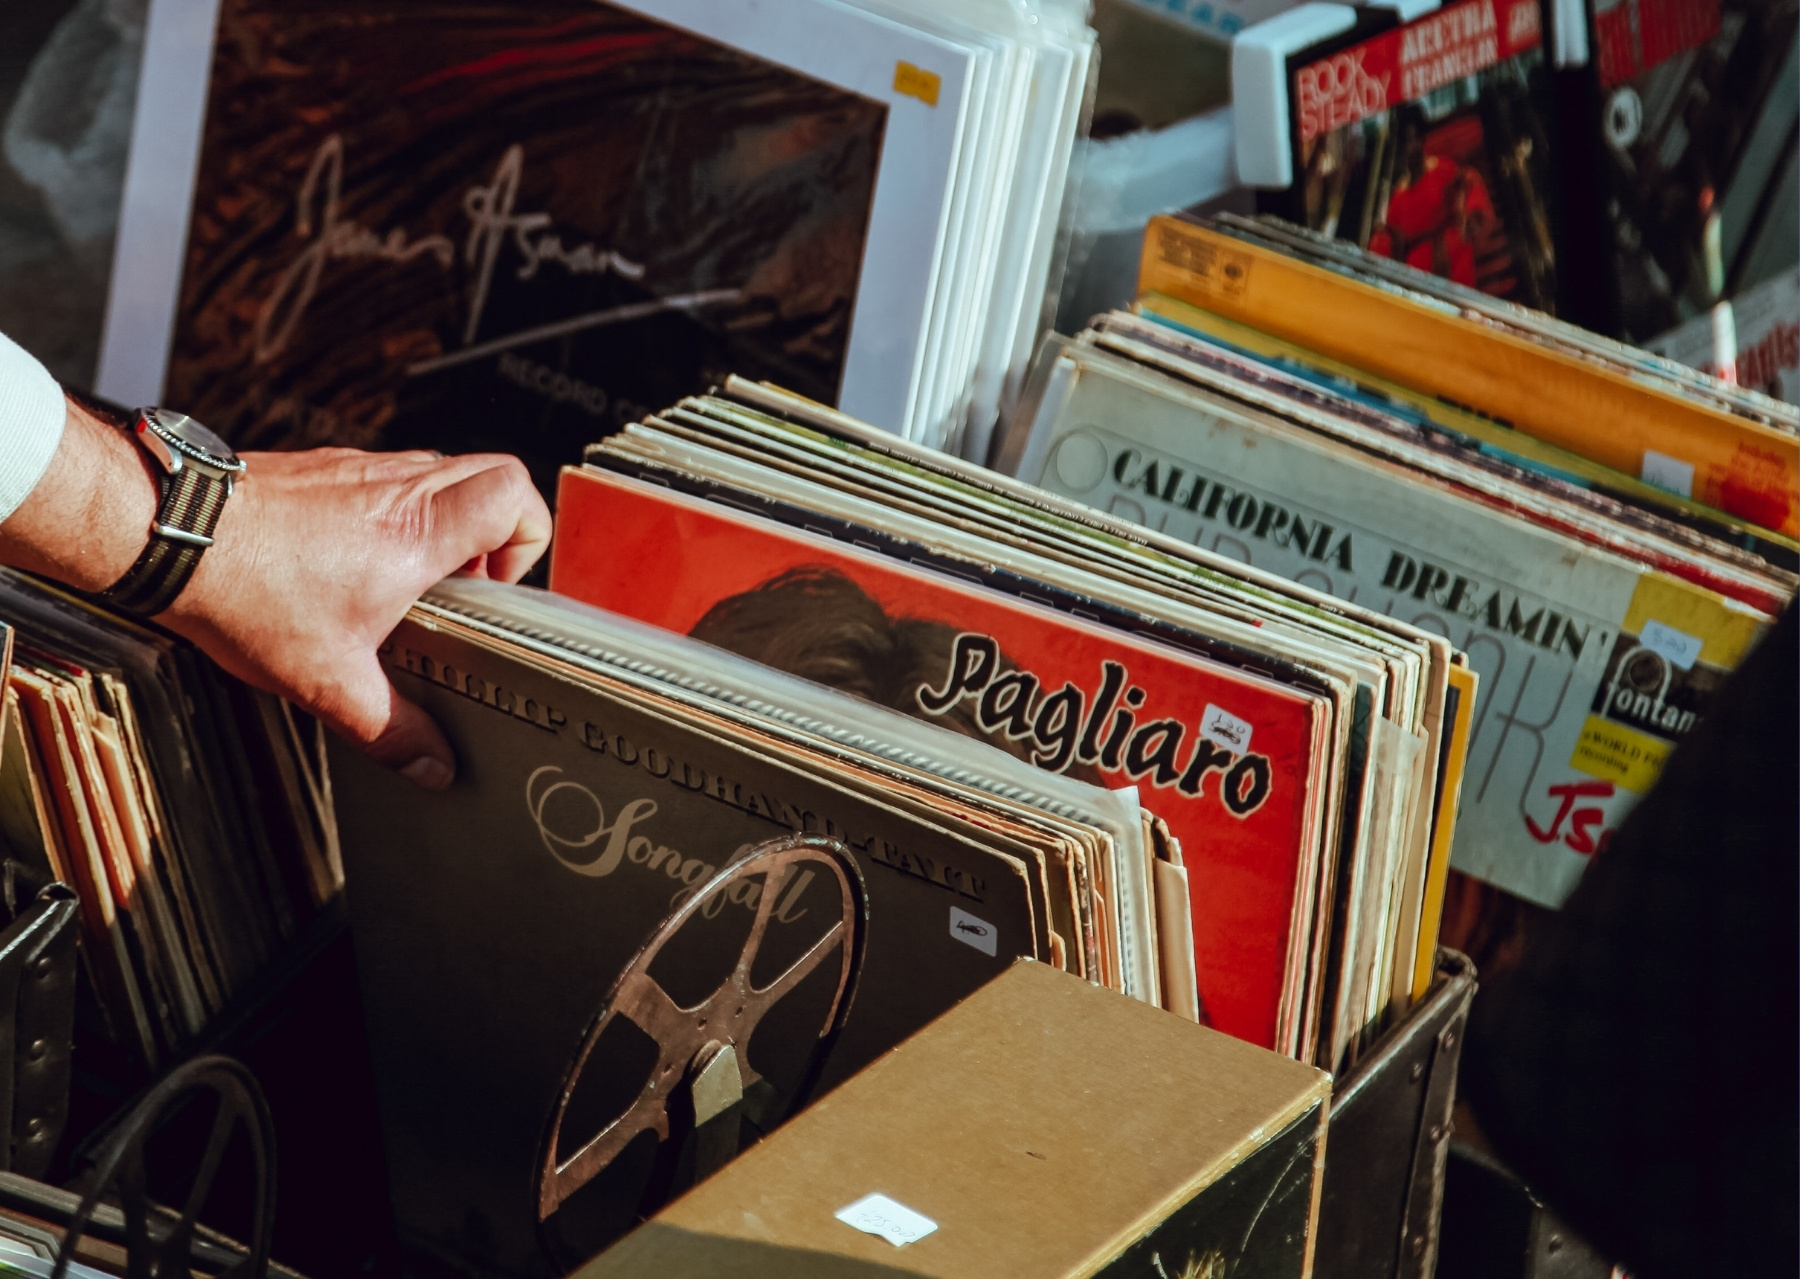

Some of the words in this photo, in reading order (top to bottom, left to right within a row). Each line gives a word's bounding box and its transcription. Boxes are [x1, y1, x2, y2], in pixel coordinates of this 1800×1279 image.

[497, 351, 608, 416] RECORD
[1113, 449, 1353, 573] CALIFORNIA
[1380, 549, 1608, 661] DREAMIN'
[916, 632, 1273, 819] Pagliaro
[1602, 666, 1698, 734] fontan
[1579, 745, 1630, 774] recording
[1592, 731, 1642, 760] WORLD
